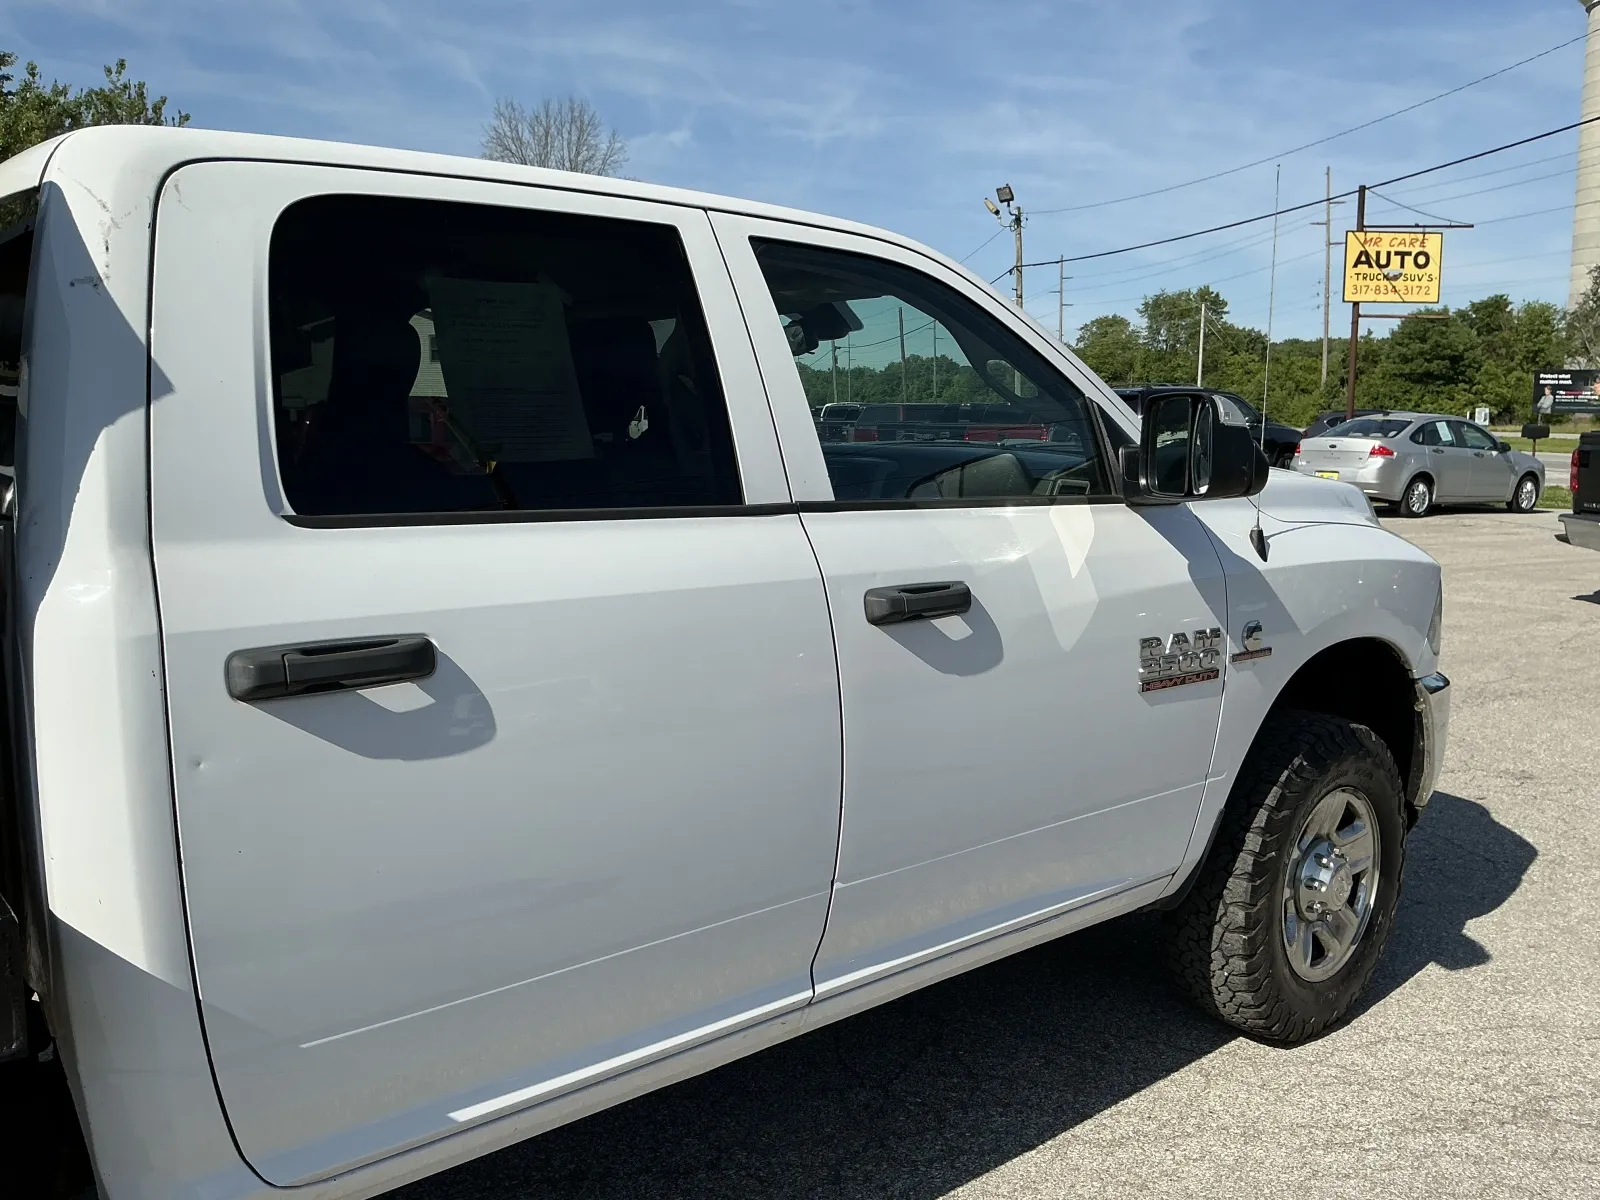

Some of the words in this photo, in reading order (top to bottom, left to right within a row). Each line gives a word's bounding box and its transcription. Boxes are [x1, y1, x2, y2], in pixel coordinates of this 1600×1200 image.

[1362, 236, 1383, 248] MR
[1388, 236, 1429, 248] CARE
[1352, 250, 1431, 270] AUTO
[1402, 272, 1434, 282] SUV'S
[1139, 626, 1221, 658] RAM
[1143, 678, 1184, 692] HEAVY
[1185, 671, 1218, 684] DUTY
